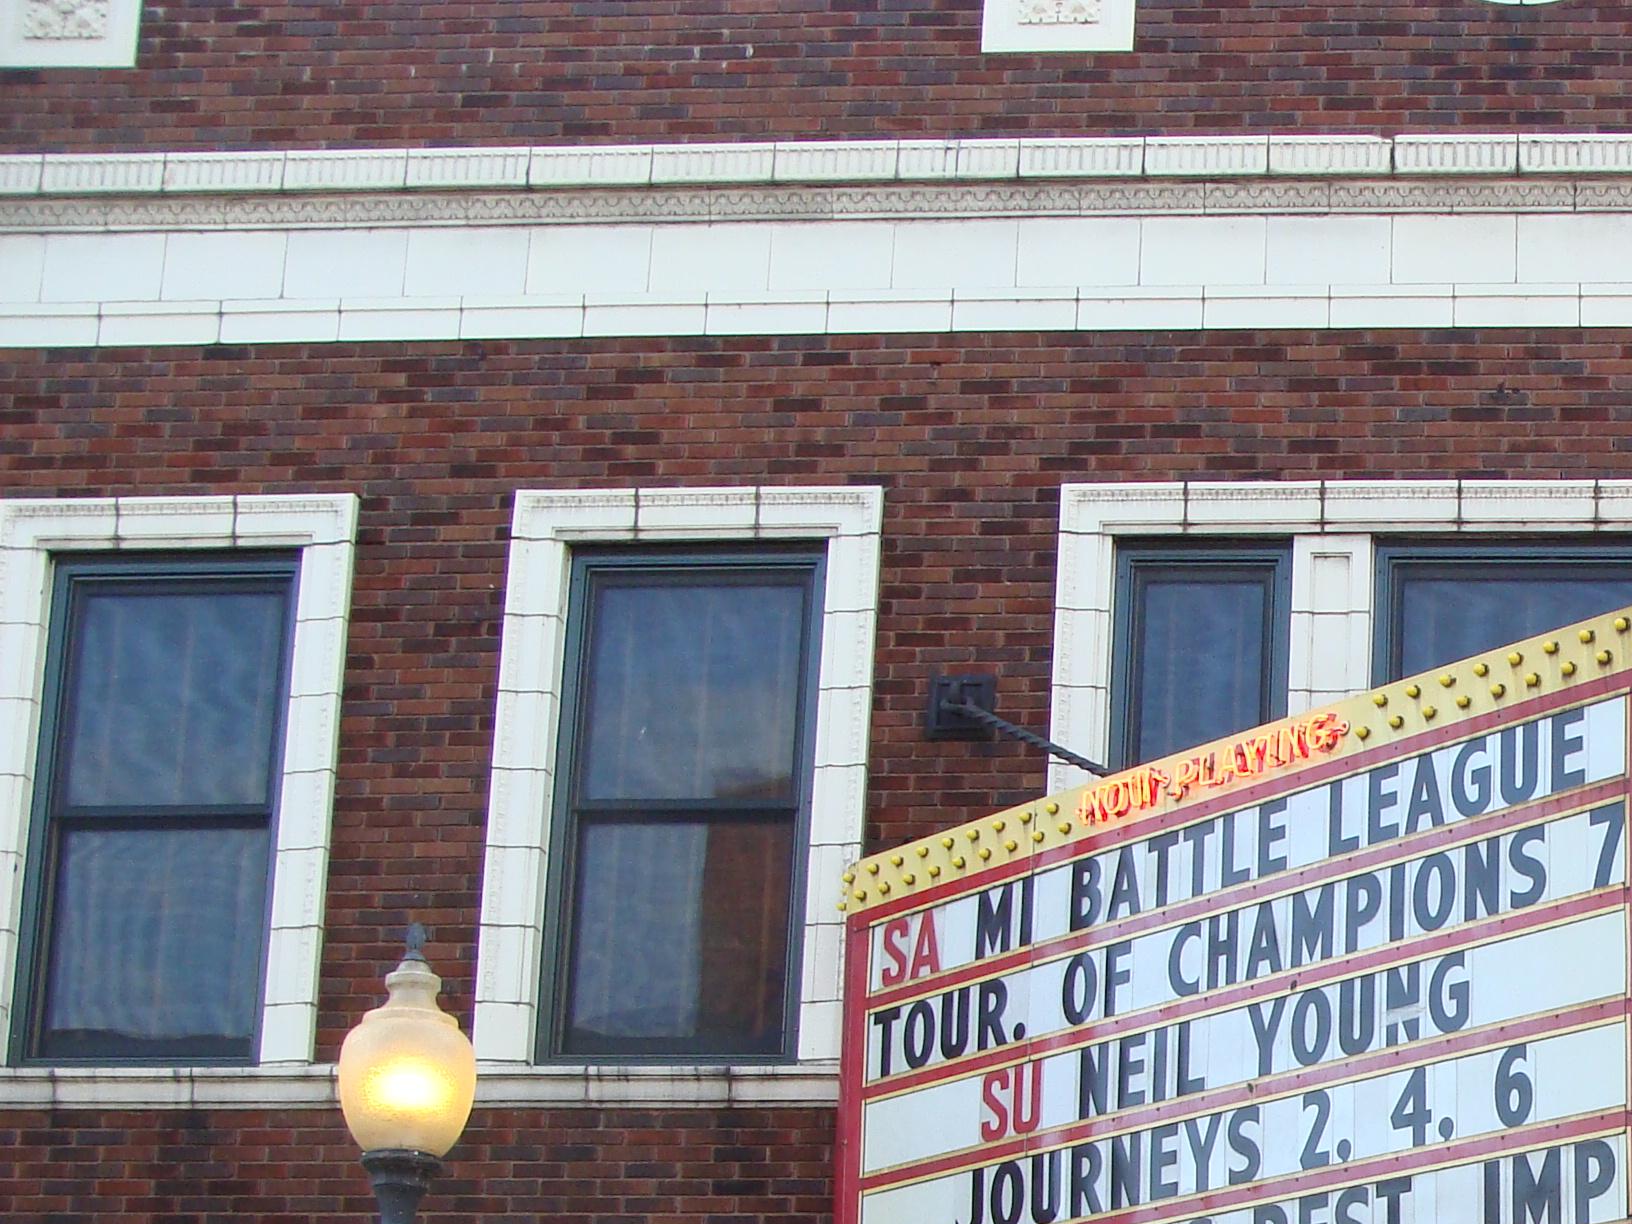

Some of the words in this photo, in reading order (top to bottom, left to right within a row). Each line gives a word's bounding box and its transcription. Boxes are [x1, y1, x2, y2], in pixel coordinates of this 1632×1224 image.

[874, 980, 1027, 1076] TOUR.
[1063, 945, 1130, 1027] OF
[1168, 828, 1546, 999] CHAMPIONS
[1588, 808, 1624, 887] 7
[881, 911, 941, 986] SA
[975, 875, 1031, 961] MI
[1070, 799, 1289, 933] BATTLE
[1329, 705, 1586, 854] LEAGUE
[980, 1060, 1042, 1144] SU
[1078, 1021, 1207, 1123] NEIL
[1246, 952, 1470, 1070] YOUNG
[1494, 1044, 1534, 1126] 6
